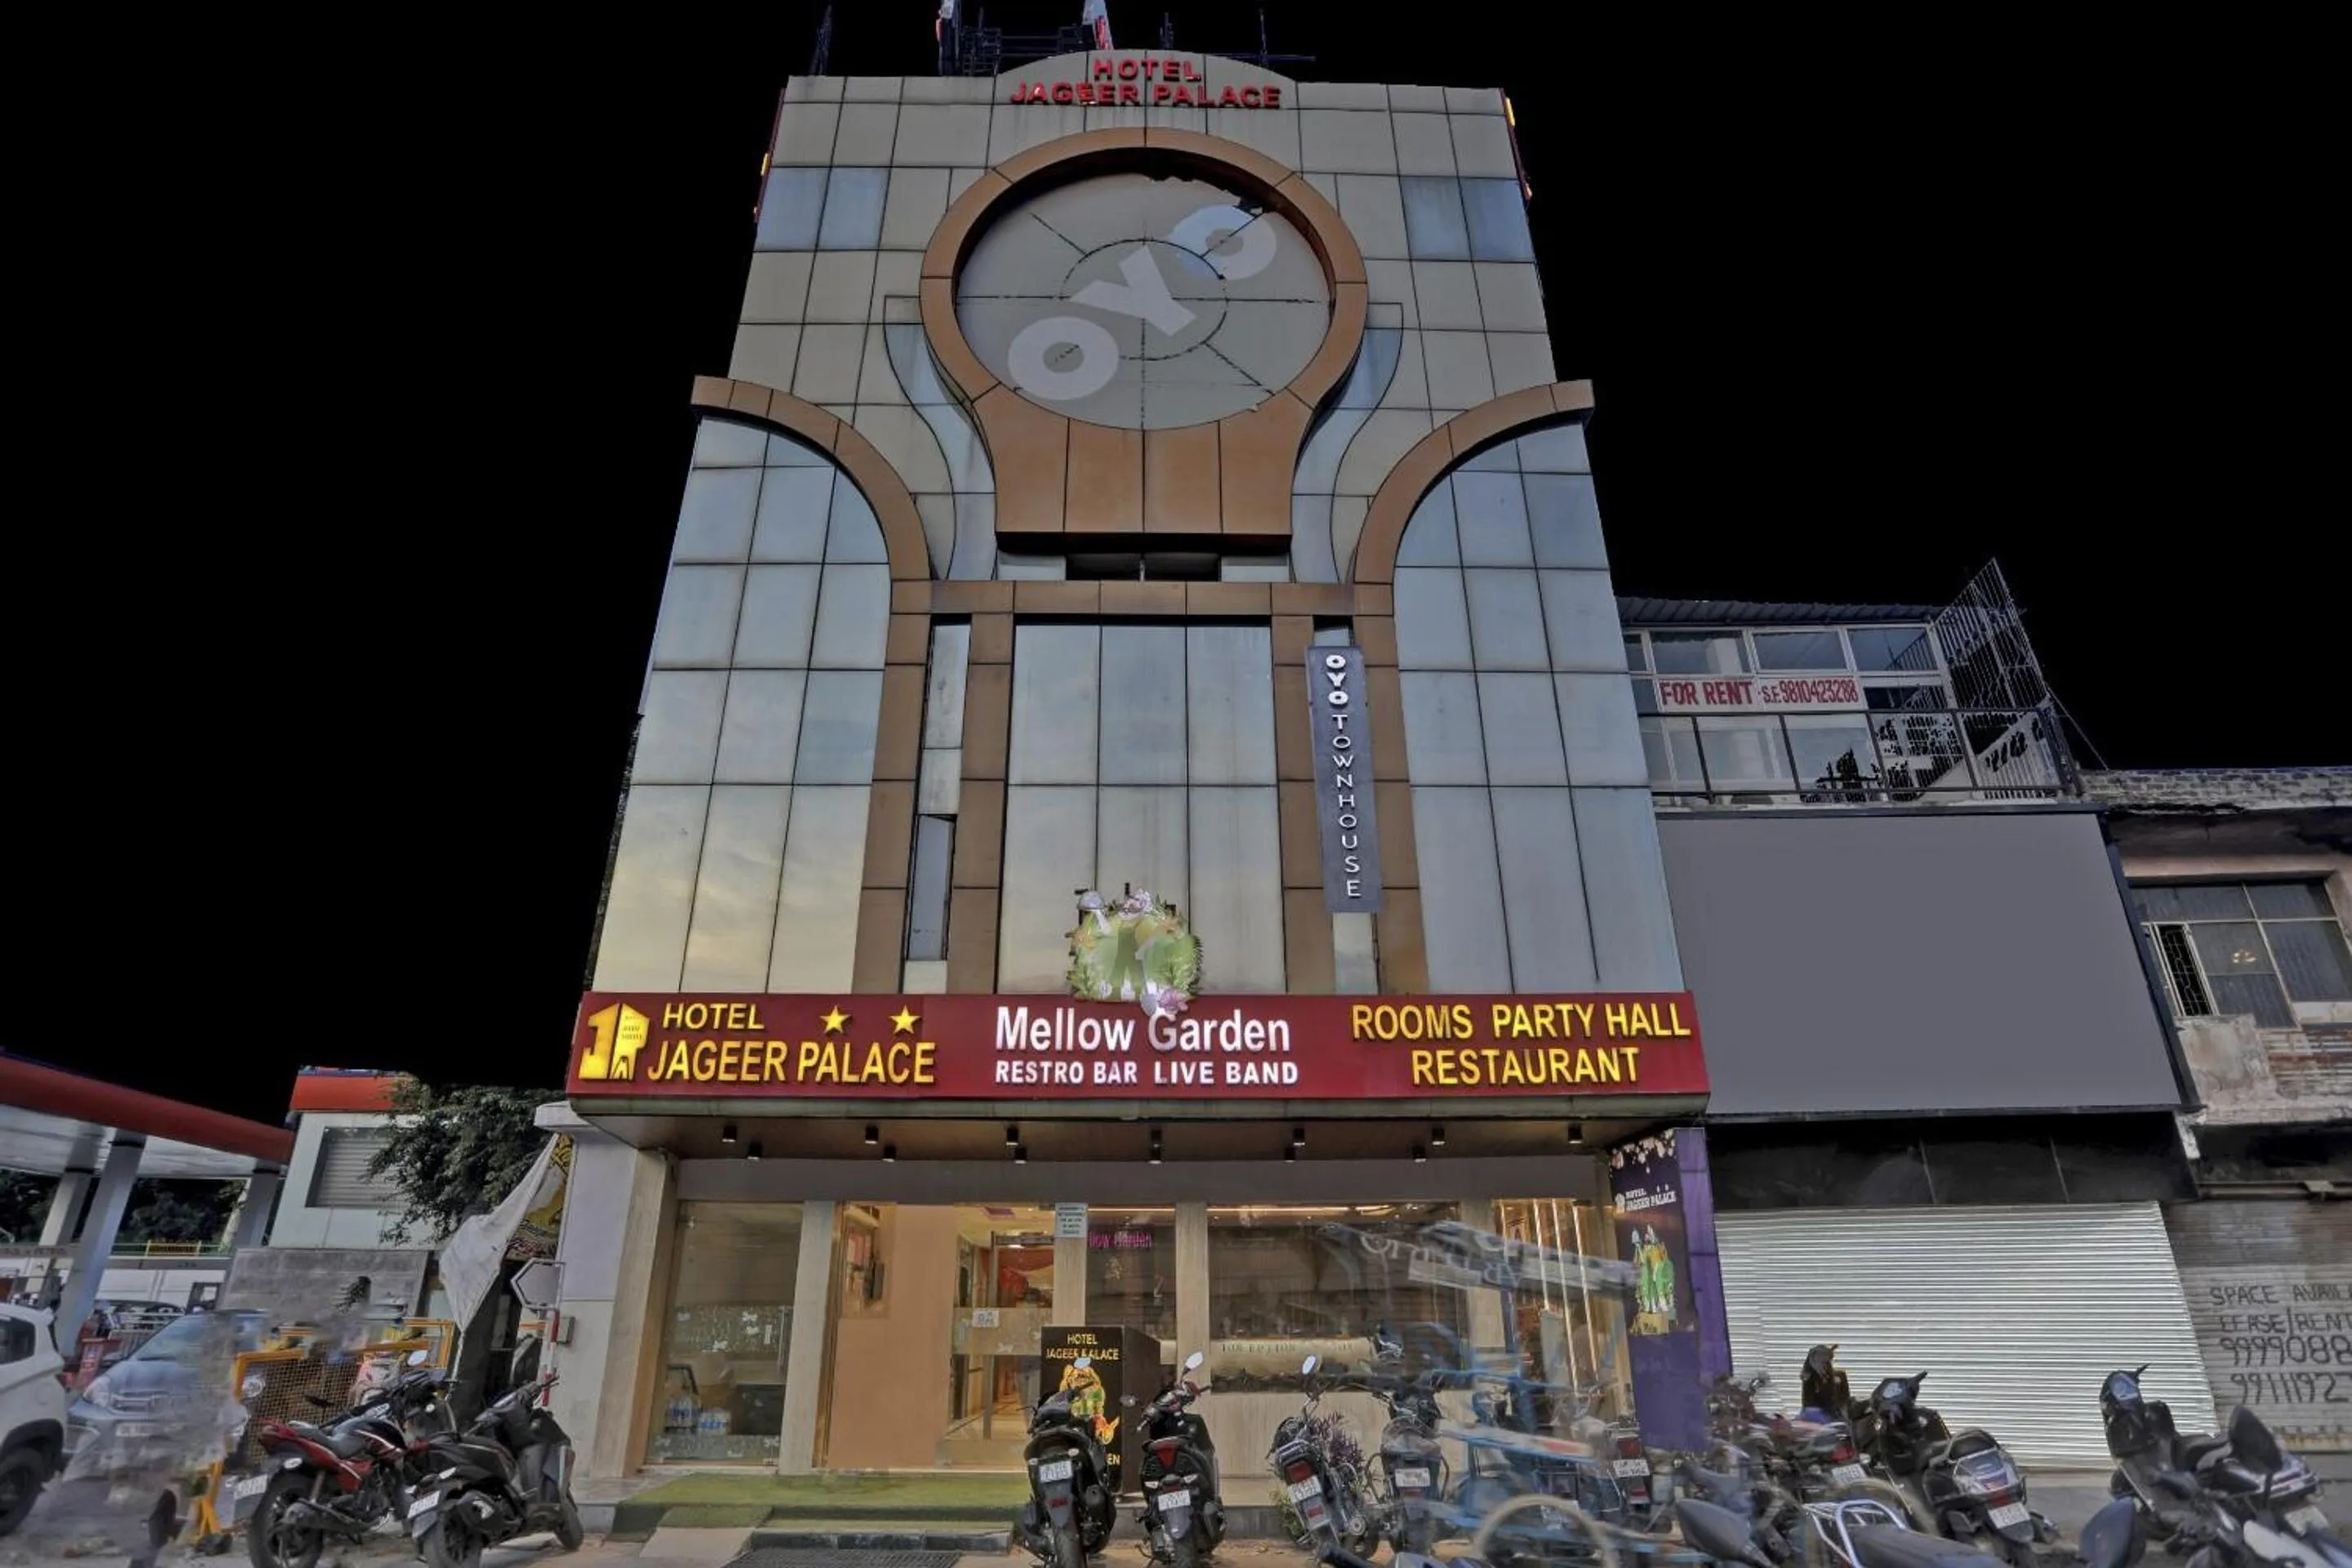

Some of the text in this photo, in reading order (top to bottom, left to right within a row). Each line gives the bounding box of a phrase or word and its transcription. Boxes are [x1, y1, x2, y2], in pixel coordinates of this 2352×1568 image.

[1093, 59, 1202, 81] HOTEL
[1010, 82, 1282, 108] JAGEER PALACE
[1008, 204, 1277, 400] OYO
[1659, 681, 1699, 706] FOR
[1703, 681, 1754, 705] RENT
[1325, 654, 1362, 897] OYO TOWNHOUSE
[662, 1002, 766, 1031] HOTEL
[995, 1005, 1291, 1053] Mellow Garden
[1352, 1001, 1692, 1040] ROOMS PARTY HALL
[647, 1039, 936, 1084] JAGEER PALACE
[995, 1060, 1299, 1085] RESTRO BAR LIVE BAND
[1412, 1047, 1641, 1085] RESTAURANT
[2209, 1285, 2279, 1306] SPACE
[1067, 1334, 1098, 1345] HOTEL
